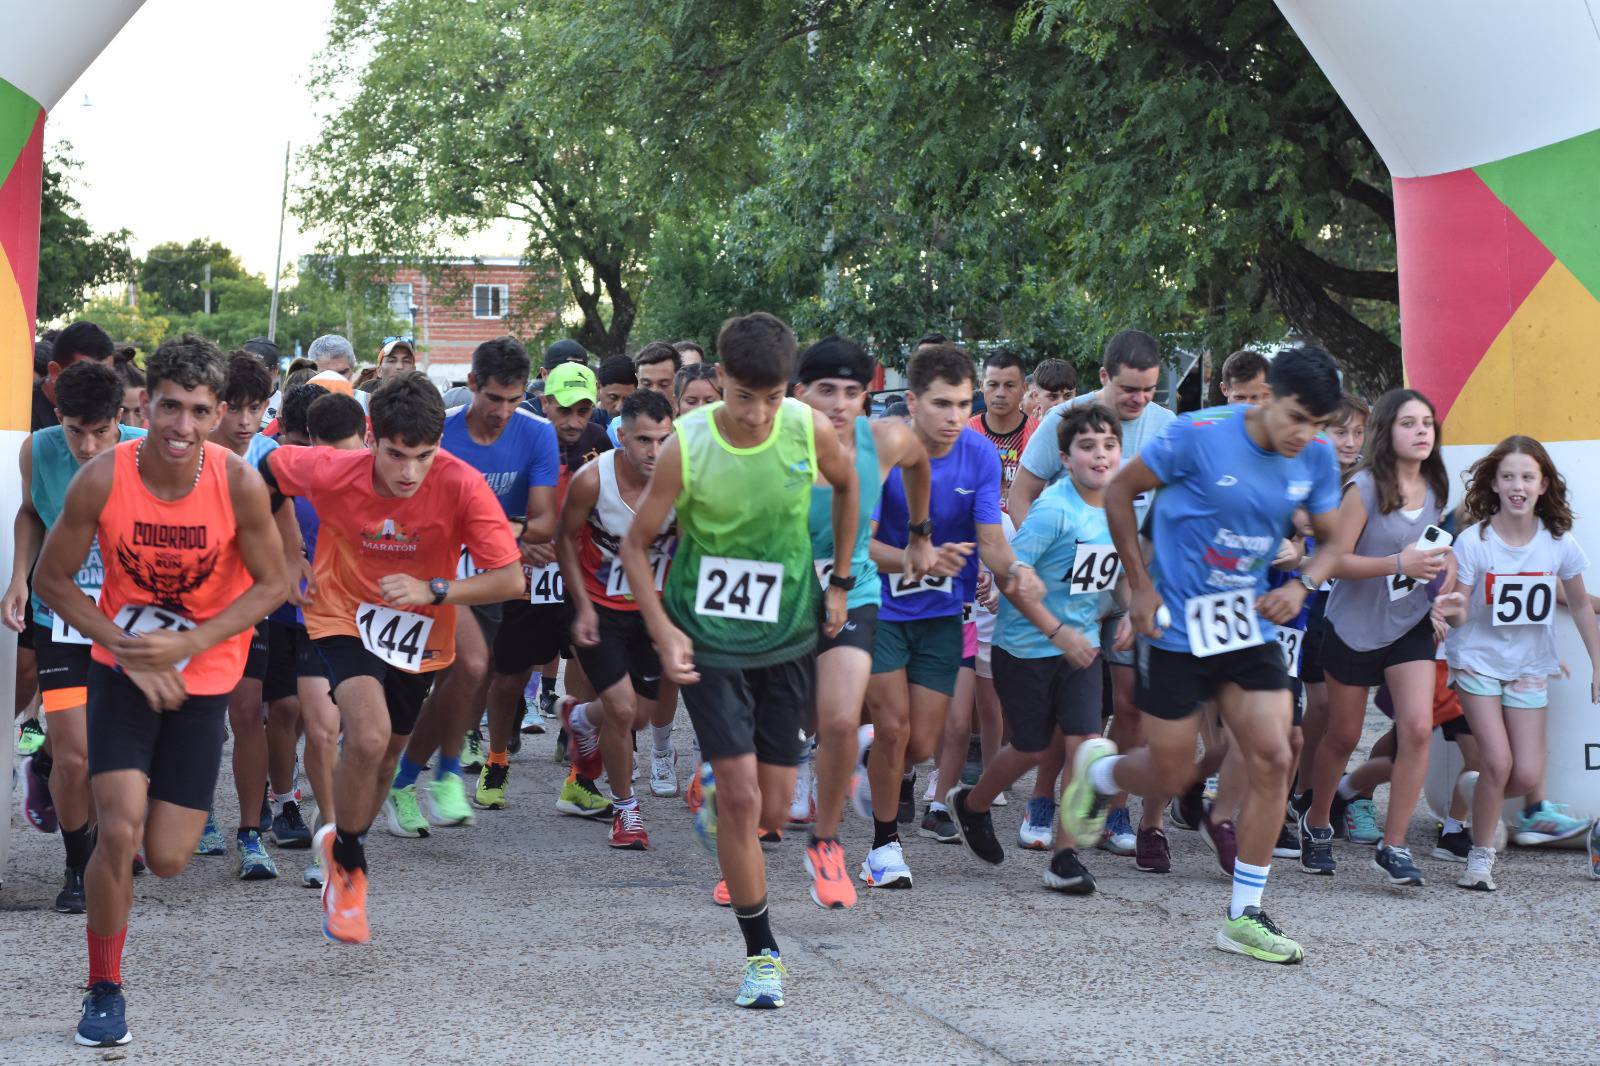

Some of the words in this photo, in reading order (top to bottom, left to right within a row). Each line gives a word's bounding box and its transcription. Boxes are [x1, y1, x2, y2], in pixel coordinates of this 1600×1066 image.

[133, 522, 206, 549] COLORADO
[704, 568, 777, 615] 247
[1072, 552, 1119, 591] 49
[1192, 596, 1252, 649] 158
[1497, 583, 1552, 622] 50
[360, 609, 424, 664] 144
